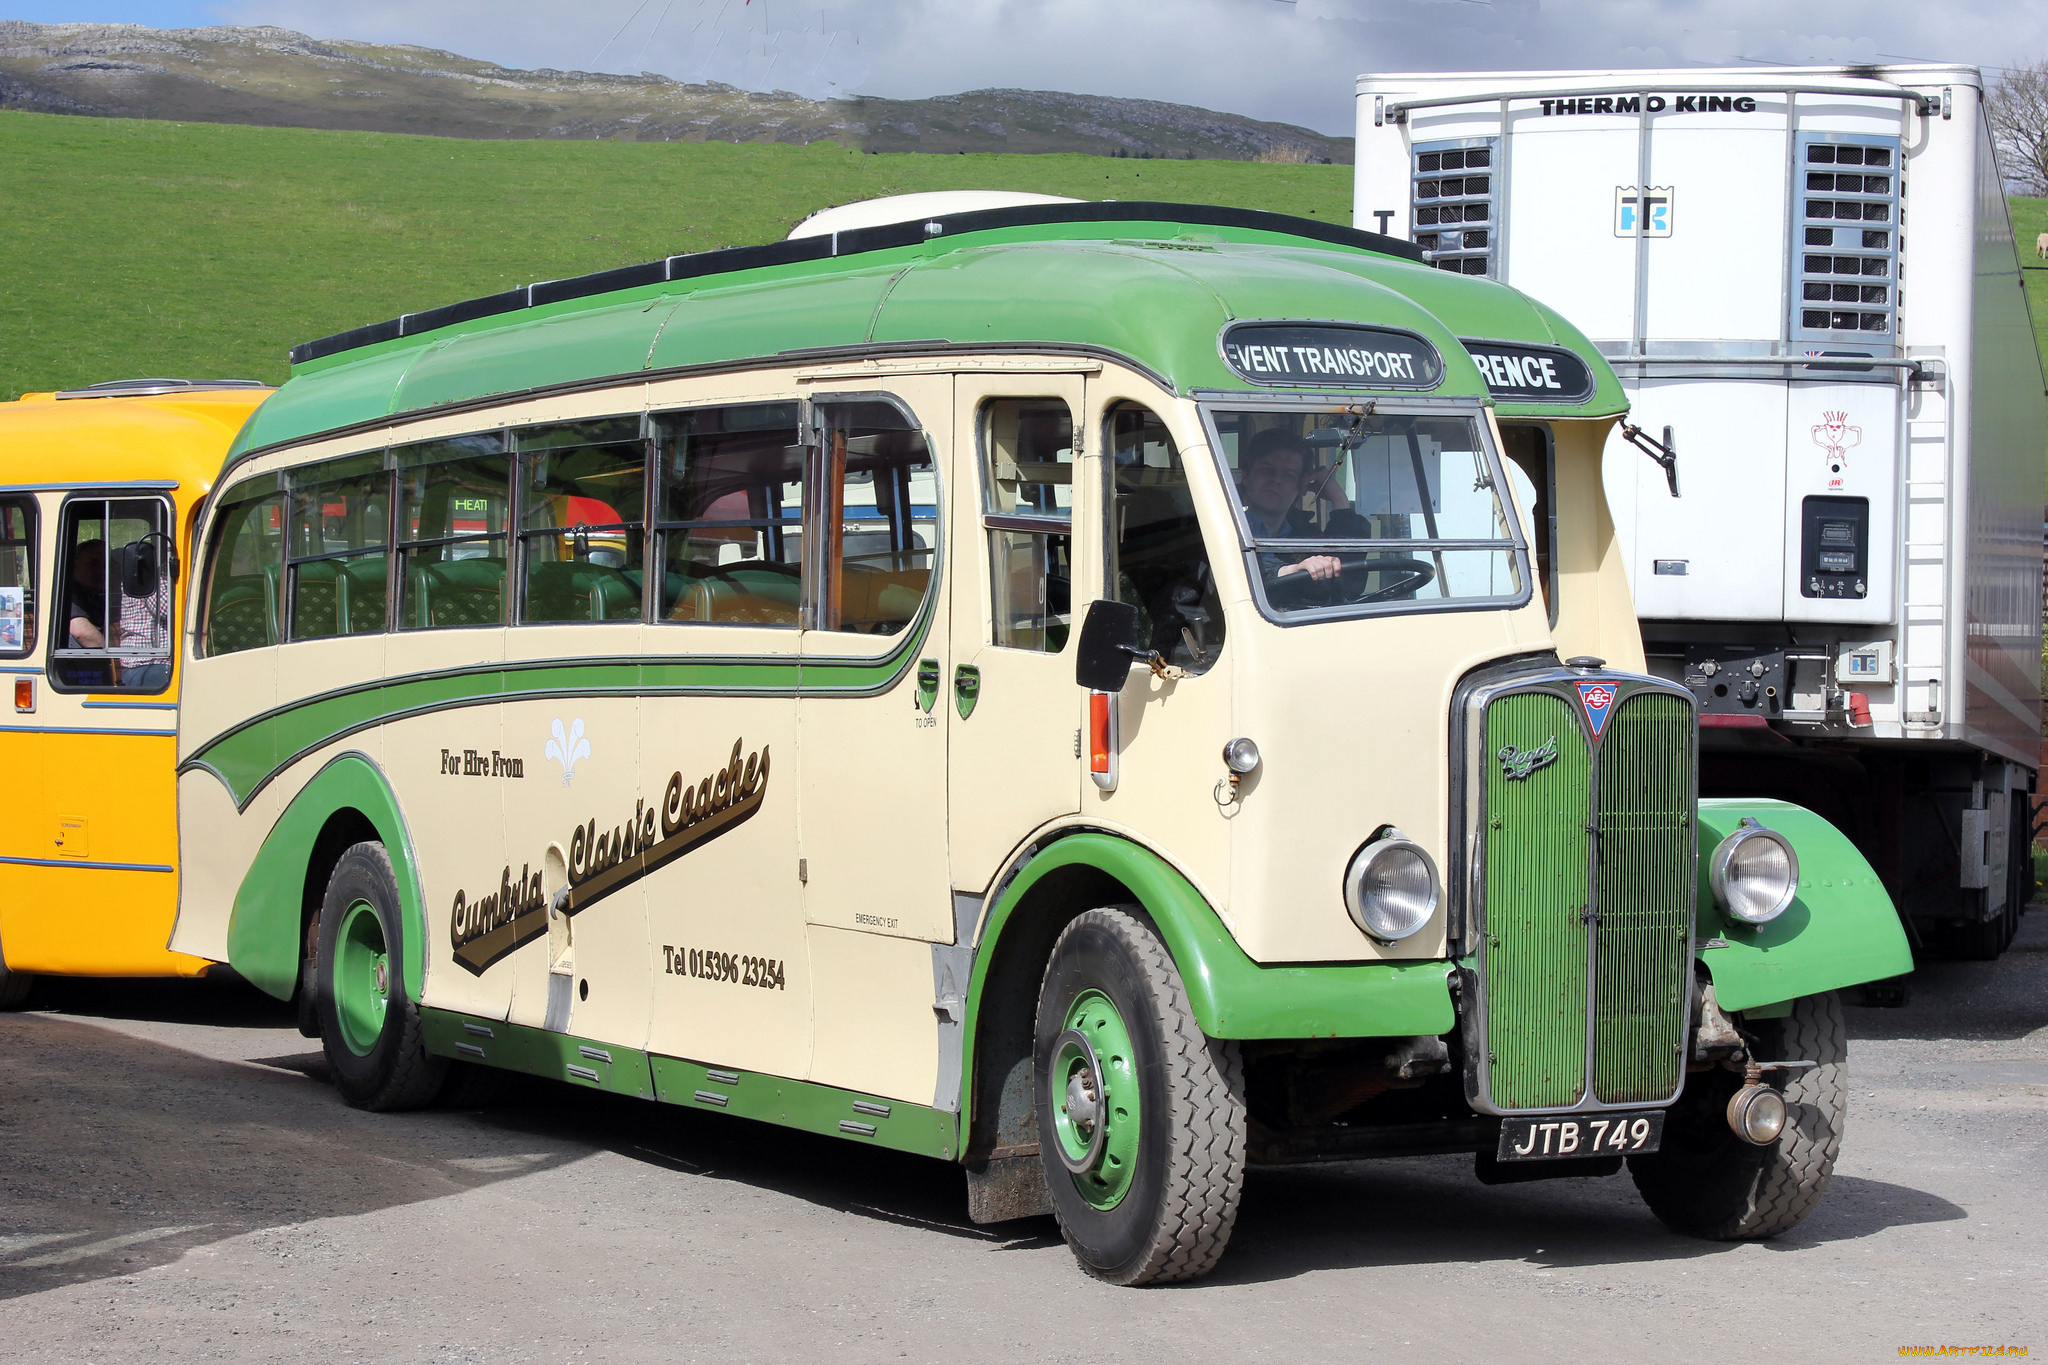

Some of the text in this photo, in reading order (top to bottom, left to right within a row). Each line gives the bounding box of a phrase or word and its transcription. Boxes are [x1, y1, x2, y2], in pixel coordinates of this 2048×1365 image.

[1540, 95, 1756, 116] THERMO KING
[1373, 210, 1395, 235] T
[1293, 347, 1415, 379] TRANSPORT
[1470, 354, 1562, 389] RENCE
[1585, 693, 1610, 703] AEC
[915, 717, 937, 728] TO OPEN
[441, 749, 524, 778] For Hire From
[1498, 735, 1558, 778] Regal
[450, 737, 770, 951] Cumbria Classic Coaches
[856, 913, 898, 928] EMERGENCY EXIT
[663, 945, 785, 990] Tel 015396 23254
[1514, 1118, 1650, 1155] JTB 749
